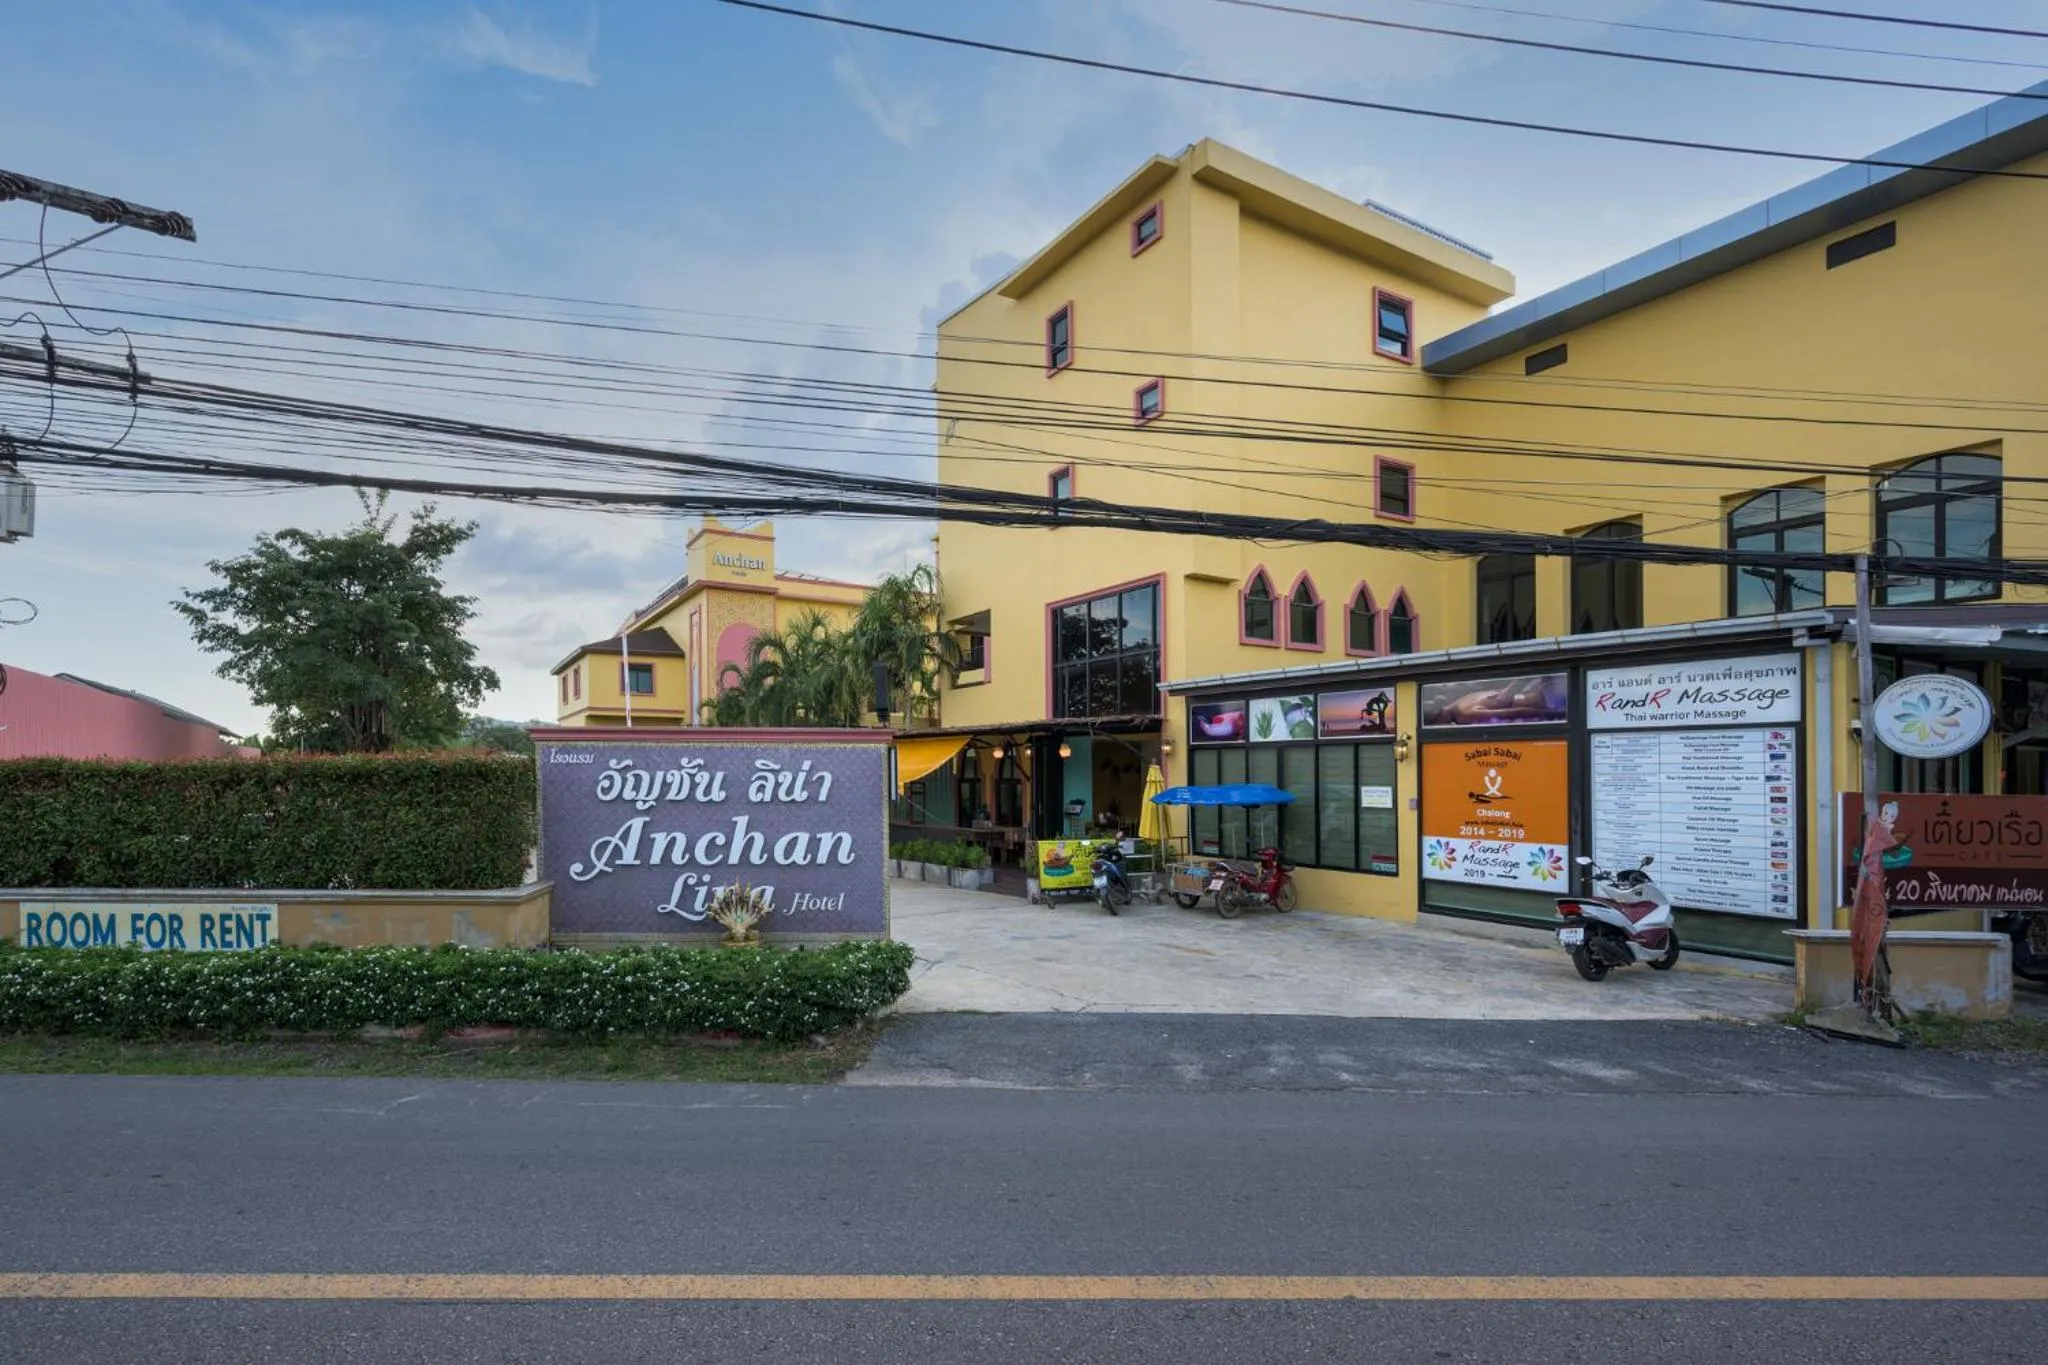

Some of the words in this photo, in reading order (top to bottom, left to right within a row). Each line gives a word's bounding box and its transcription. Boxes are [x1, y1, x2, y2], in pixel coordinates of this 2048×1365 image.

[1677, 688, 1791, 710] Massage
[1624, 713, 1647, 722] Thai
[1650, 711, 1690, 721] warrior
[1694, 709, 1747, 720] Massage
[596, 758, 727, 811] อัญชัน
[748, 759, 833, 802] ลิน่า
[1459, 826, 1485, 836] 2014
[1498, 828, 1525, 839] 2019
[569, 815, 856, 882] Anchan
[1462, 854, 1521, 874] Massage
[1464, 868, 1486, 878] 2019
[1897, 879, 1920, 900] 20
[1925, 871, 1993, 902] สิงหาคม
[783, 893, 844, 915] Hotel
[26, 911, 117, 949] ROOM
[131, 912, 186, 949] FOR
[201, 912, 272, 950] RENT
